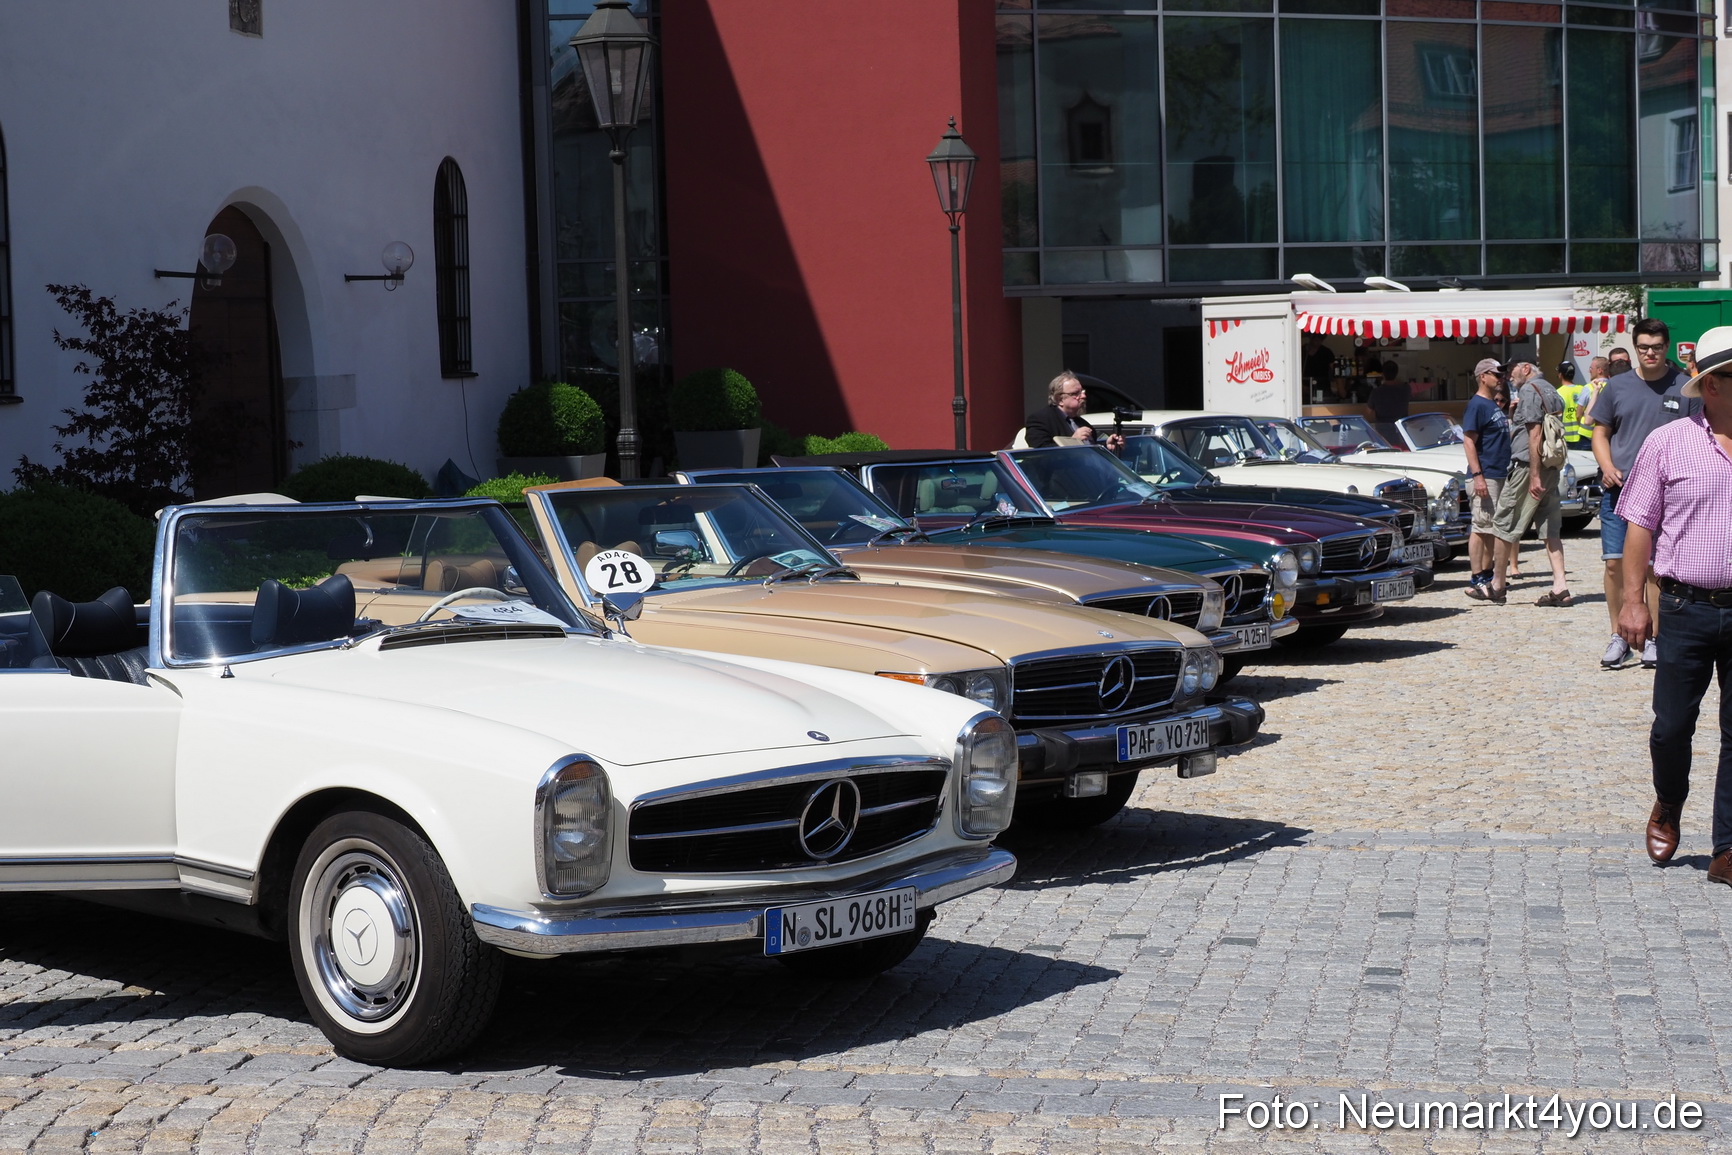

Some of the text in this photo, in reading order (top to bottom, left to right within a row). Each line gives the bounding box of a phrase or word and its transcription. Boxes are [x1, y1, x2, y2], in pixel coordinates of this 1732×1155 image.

[1253, 370, 1271, 381] IMBISS
[597, 551, 629, 562] ADAC
[600, 561, 642, 588] 28
[1129, 727, 1155, 756] PAF
[903, 893, 914, 903] 04
[782, 894, 901, 946] N SL 968H
[903, 914, 913, 925] 10
[770, 936, 777, 946] D
